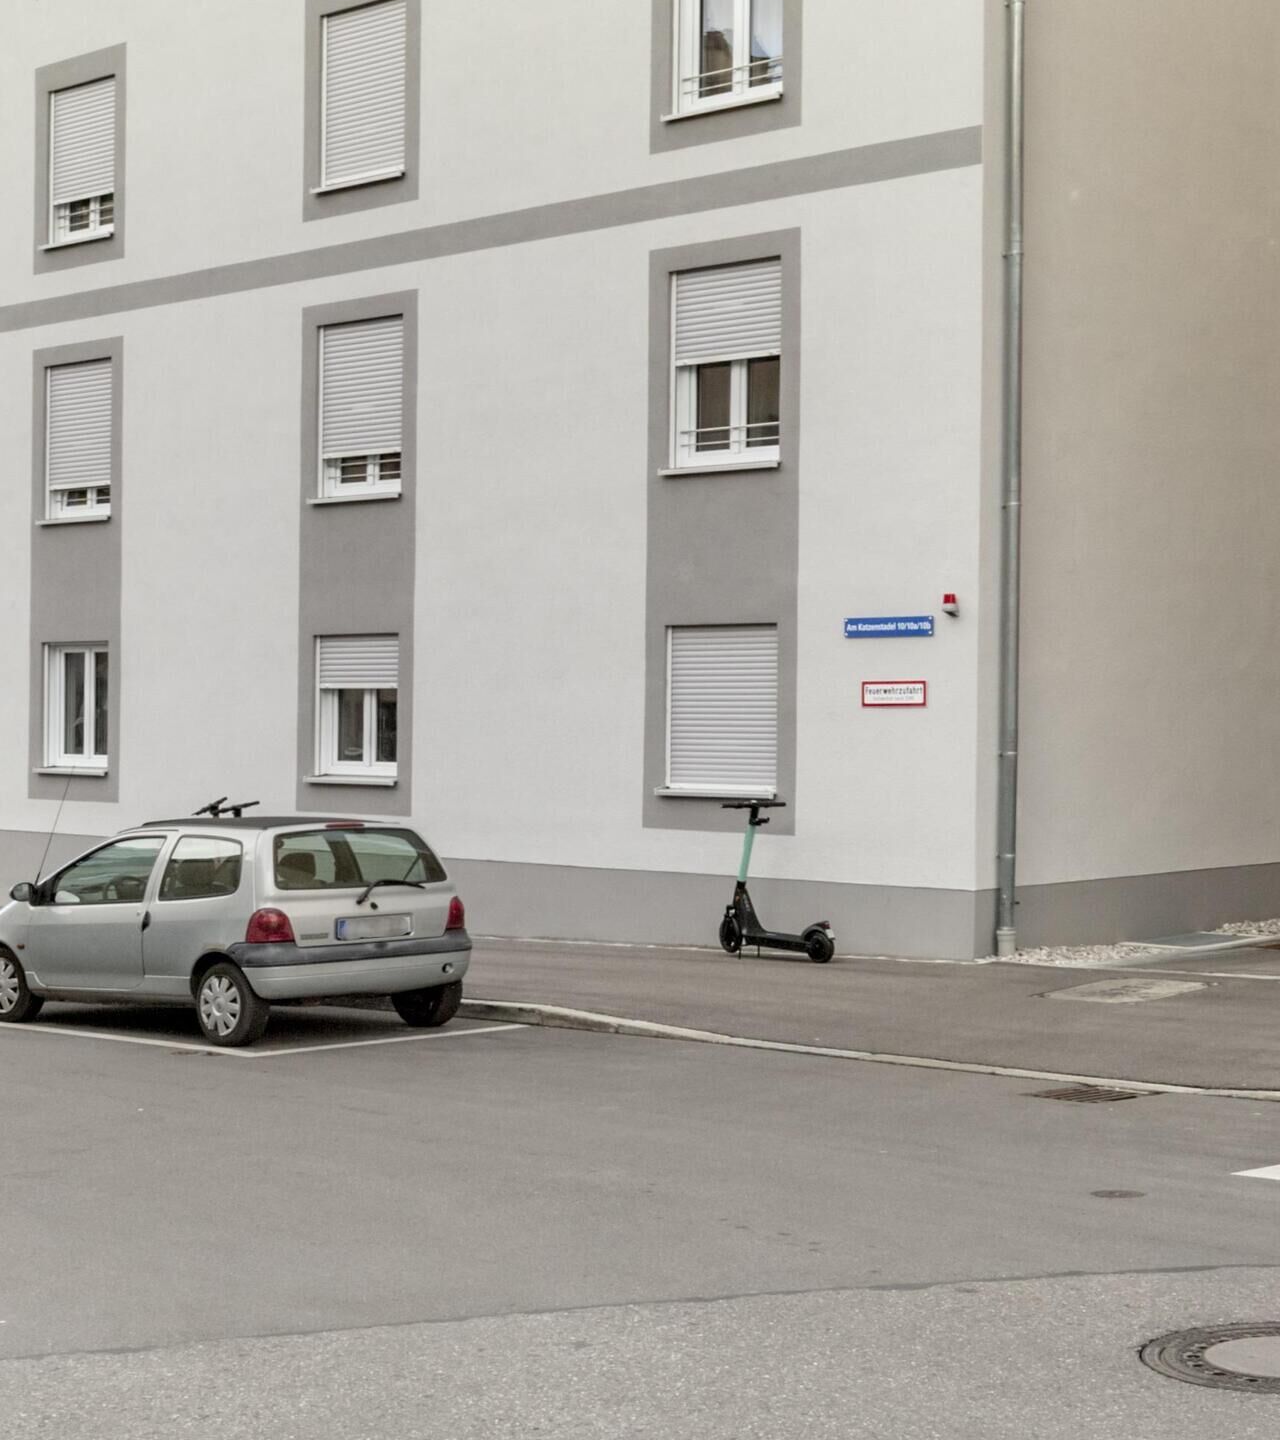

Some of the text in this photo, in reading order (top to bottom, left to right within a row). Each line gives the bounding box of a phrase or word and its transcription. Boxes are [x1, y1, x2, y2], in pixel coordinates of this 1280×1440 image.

[846, 623, 857, 632] Am
[858, 622, 896, 632] Katzenstadel
[865, 686, 923, 696] Feuerwehrzufahrt
